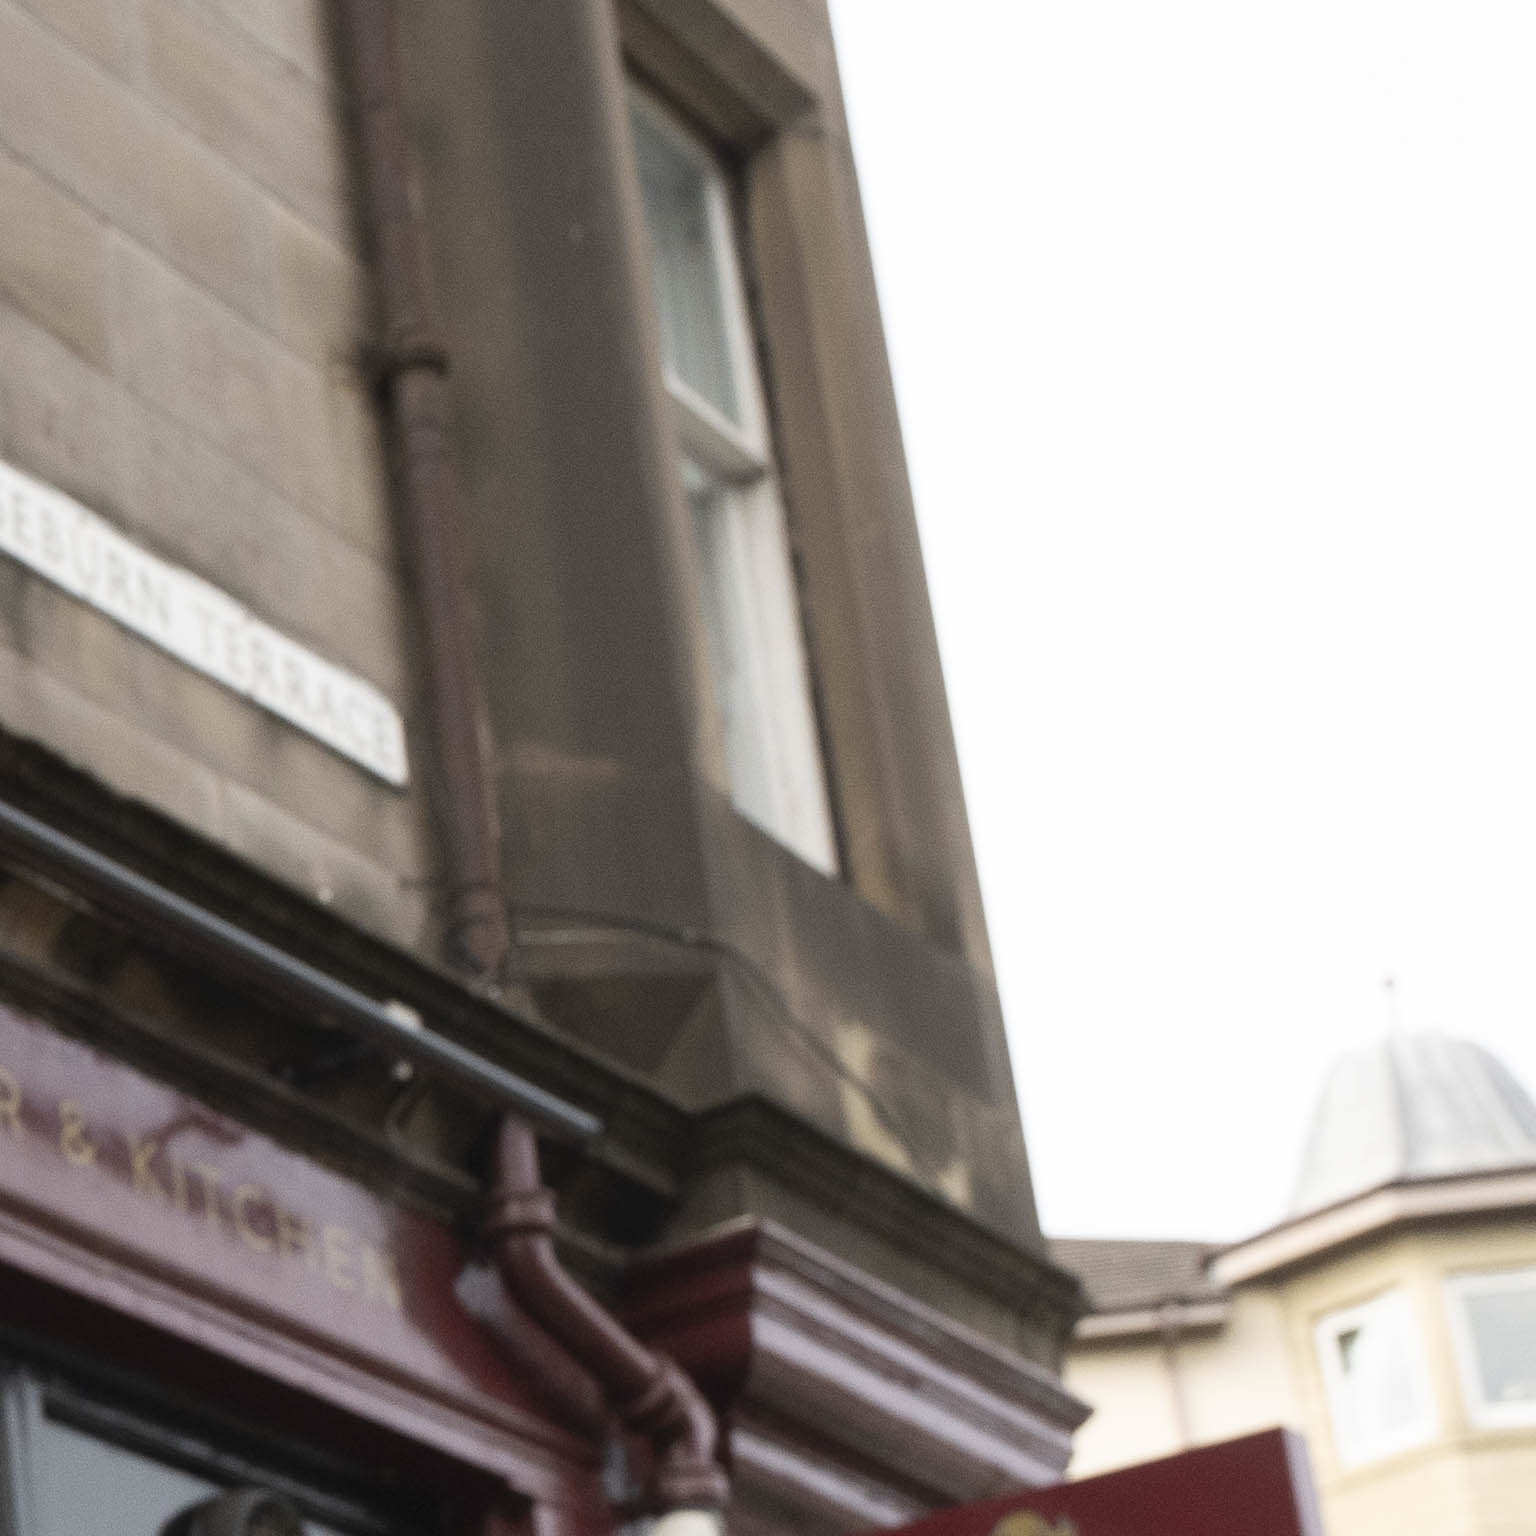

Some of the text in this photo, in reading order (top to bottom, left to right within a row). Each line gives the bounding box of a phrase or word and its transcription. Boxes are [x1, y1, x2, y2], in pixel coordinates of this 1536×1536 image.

[193, 598, 396, 765] TERRACE
[58, 1098, 98, 1167] &
[128, 1131, 404, 1312] KITCHEN
